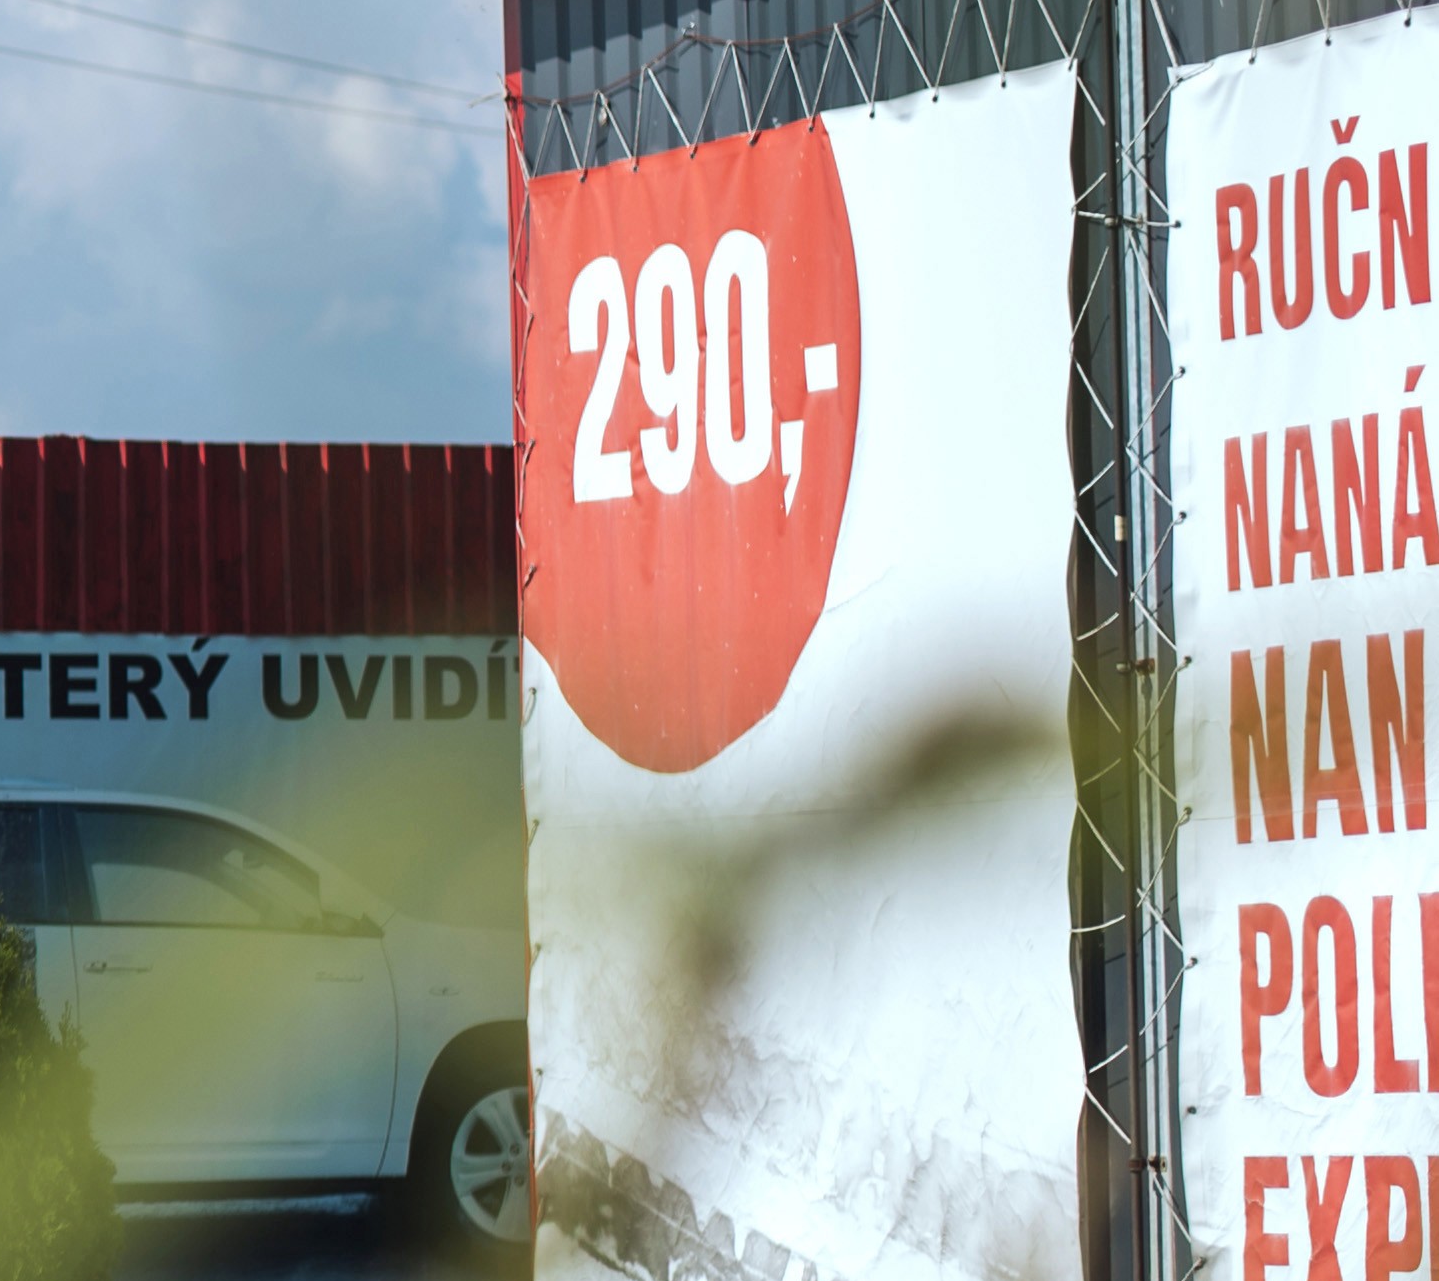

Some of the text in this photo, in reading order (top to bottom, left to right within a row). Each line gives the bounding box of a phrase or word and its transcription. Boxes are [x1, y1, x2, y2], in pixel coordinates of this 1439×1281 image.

[1215, 114, 1432, 342] RUČN
[567, 229, 839, 517] 290,-
[1223, 364, 1439, 593] NANÁ
[260, 639, 521, 721] UVIDÍ
[1229, 628, 1427, 845] NAN
